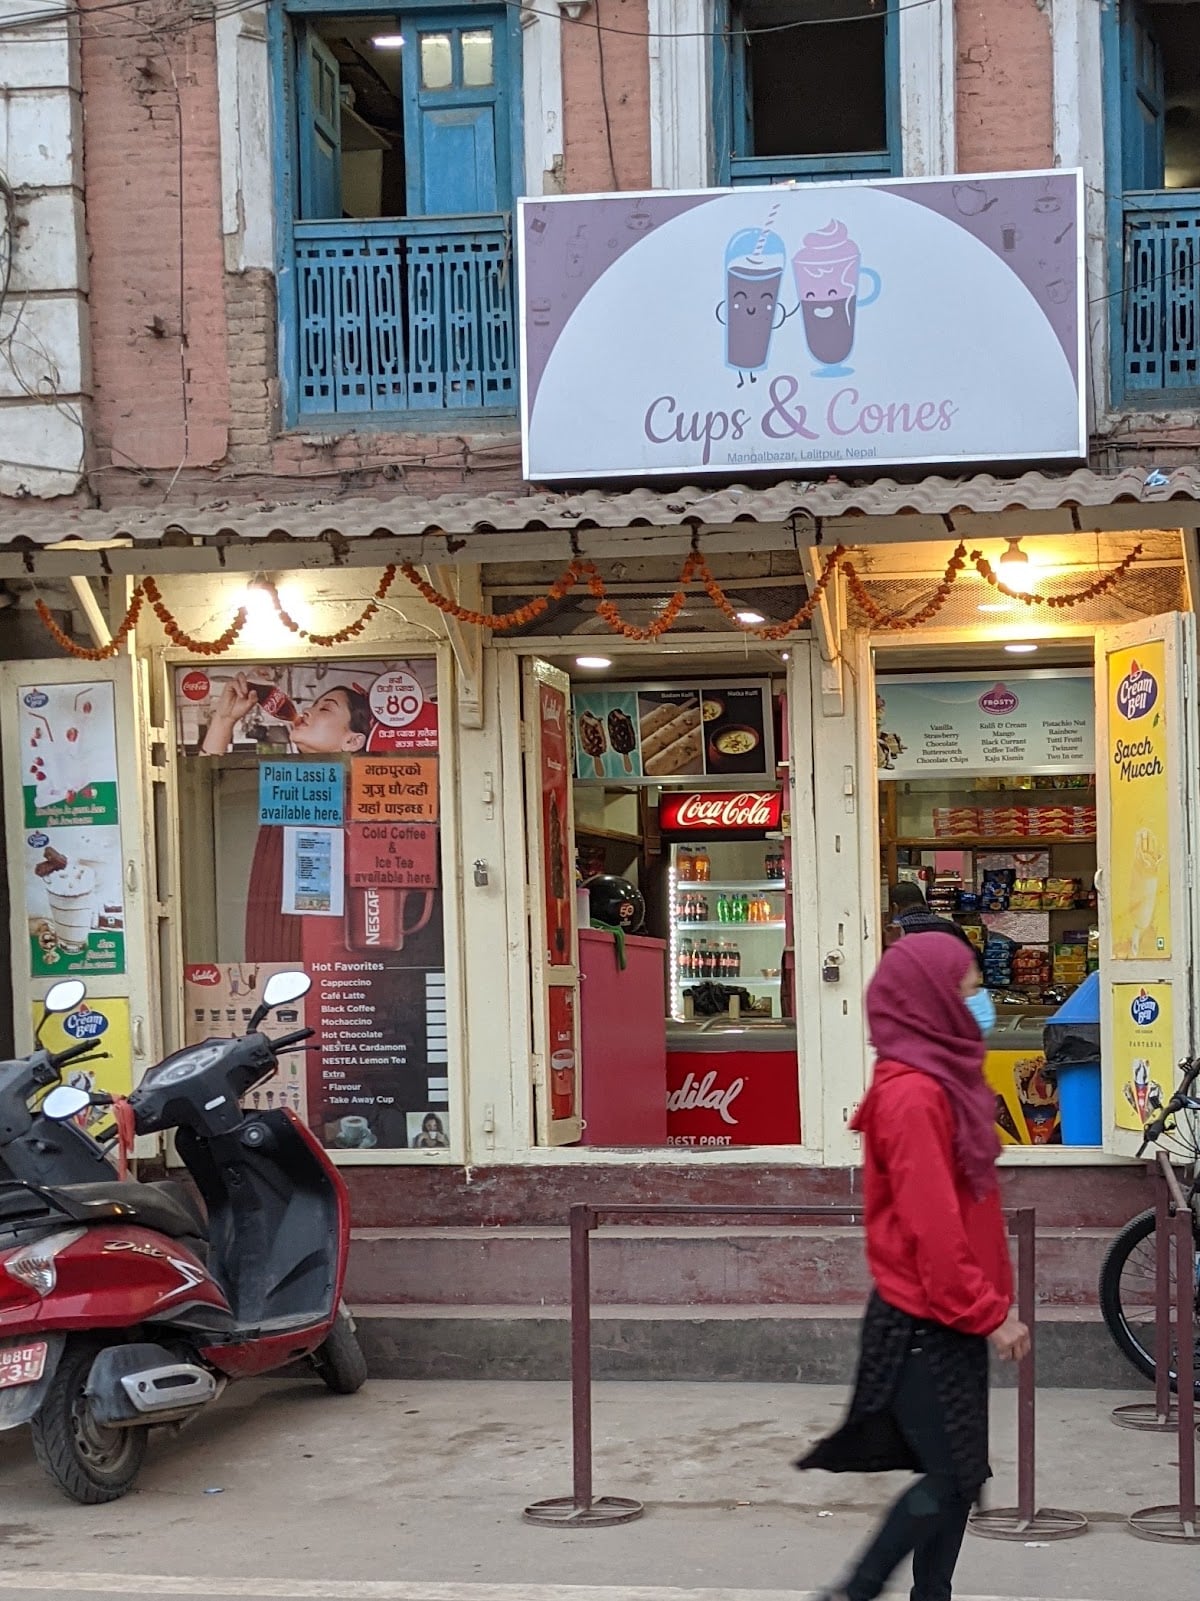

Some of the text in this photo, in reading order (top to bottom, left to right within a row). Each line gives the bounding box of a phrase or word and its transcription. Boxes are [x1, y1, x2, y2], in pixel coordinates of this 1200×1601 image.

[644, 375, 960, 466] Cups & Cones
[727, 446, 877, 464] Mangalbazar, Lalitpur, Nepal
[1120, 678, 1153, 704] Cream
[983, 698, 1015, 706] FROSTY
[1127, 692, 1147, 718] Bell
[1005, 721, 1028, 729] Cream
[923, 732, 959, 740] Strawberry
[992, 730, 1016, 738] Mango
[922, 748, 962, 756] Butterscotch
[1114, 736, 1153, 764] Sacch
[949, 756, 969, 765] Chips
[984, 755, 1000, 764] Kaju
[1120, 756, 1163, 782] Mucch
[264, 767, 337, 782] Plain Lassi &
[272, 785, 332, 801] Fruit Lassi
[261, 806, 342, 820] available here.
[676, 793, 776, 826] Coca-Cola
[362, 827, 426, 840] Cold Coffee
[388, 841, 397, 854] &
[375, 856, 414, 869] Ice Tea
[355, 871, 403, 884] available
[312, 962, 385, 971] Hot Favorites
[320, 979, 372, 988] Cappuccino
[320, 991, 366, 1000] Café Latte
[320, 1005, 376, 1013] Black Coffee
[67, 1014, 103, 1029] Cream
[321, 1018, 373, 1026] Mochaccino
[75, 1023, 97, 1038] Bell
[321, 1031, 383, 1039] Hot Chocolate
[321, 1043, 407, 1052] NESTEA Cardamom
[322, 1056, 407, 1065] NESTEA Lemon Tea
[322, 1071, 346, 1079] Extra
[328, 1083, 362, 1092] Flavour
[329, 1096, 395, 1105] Take Away Cup
[666, 1070, 744, 1125] dilal
[700, 1135, 732, 1145] PART
